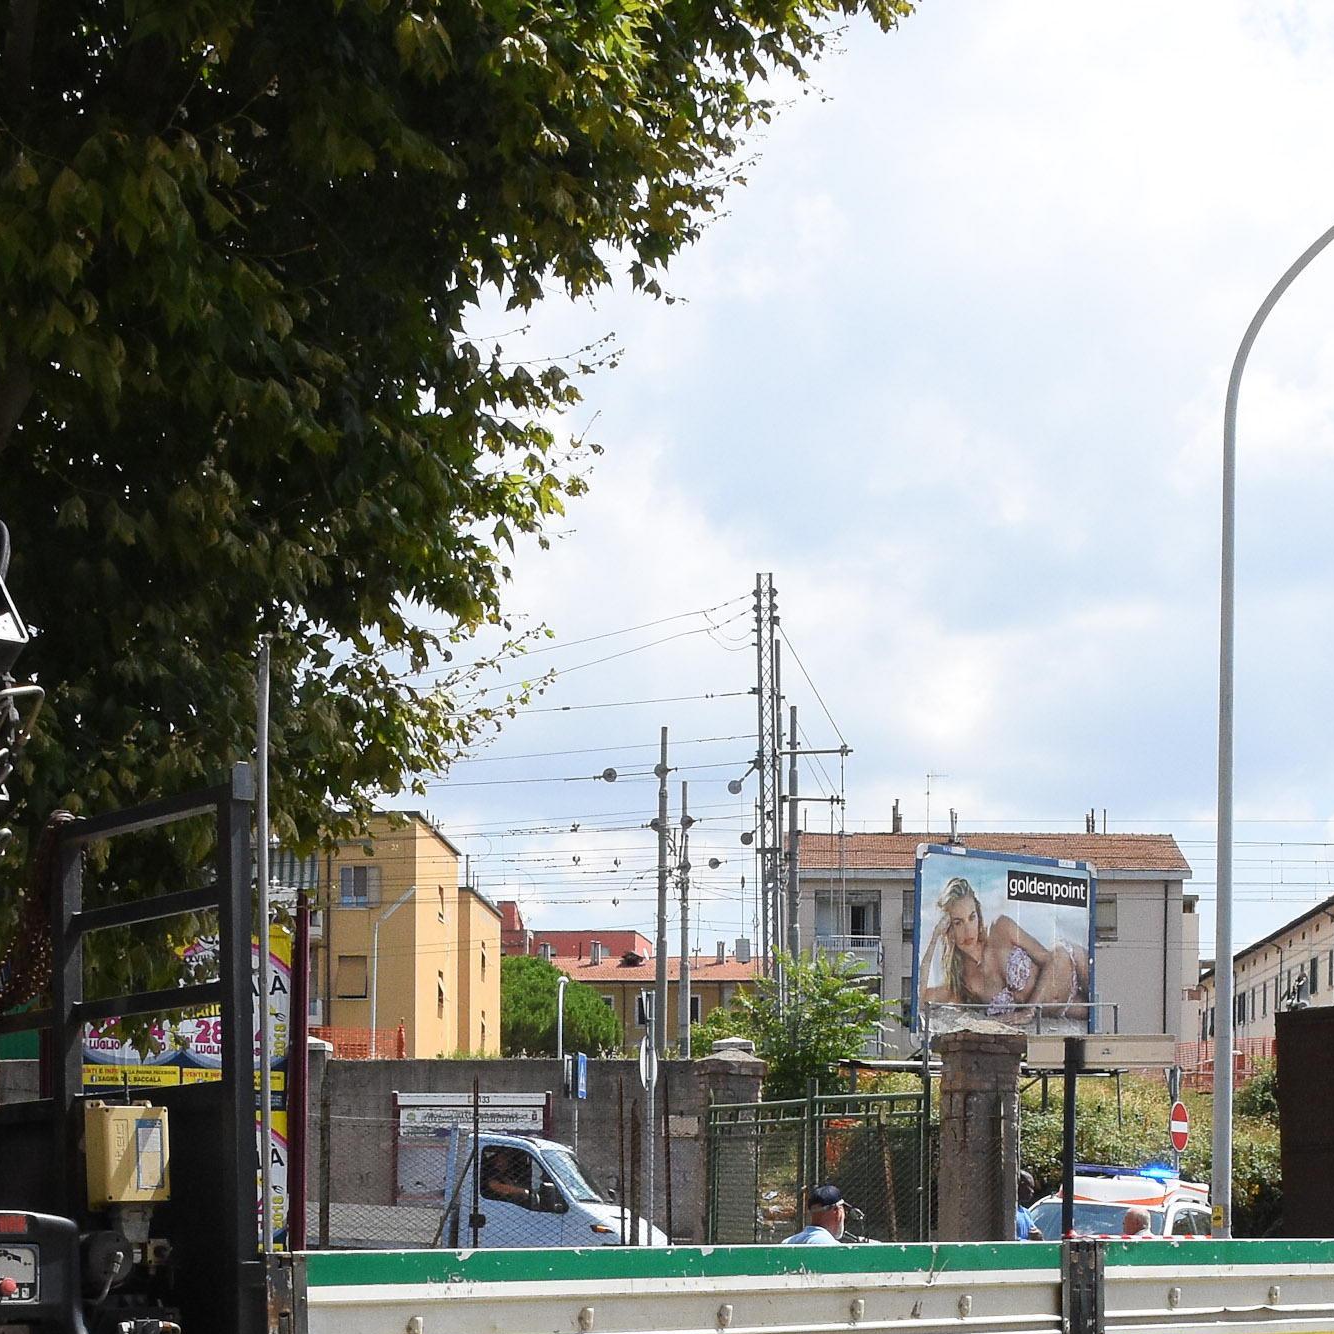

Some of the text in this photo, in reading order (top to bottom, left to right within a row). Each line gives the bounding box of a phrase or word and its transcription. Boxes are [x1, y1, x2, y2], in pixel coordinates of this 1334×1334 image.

[1009, 875, 1086, 900] goldenpoint
[89, 1040, 120, 1050] LUGLIO
[195, 1045, 220, 1055] LUGLI
